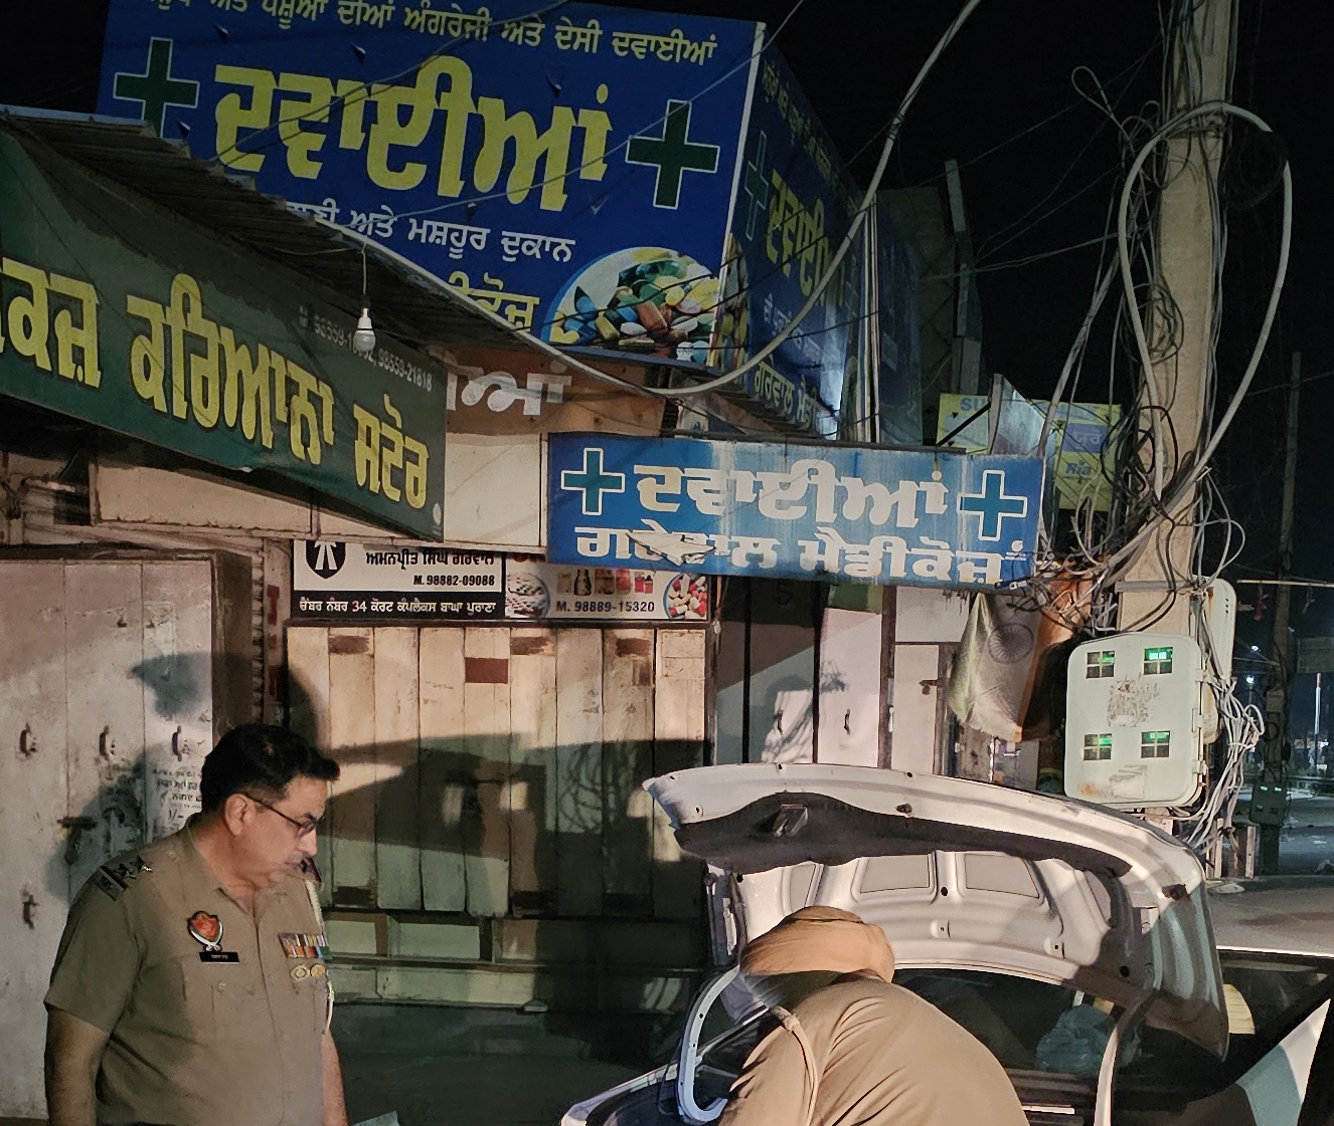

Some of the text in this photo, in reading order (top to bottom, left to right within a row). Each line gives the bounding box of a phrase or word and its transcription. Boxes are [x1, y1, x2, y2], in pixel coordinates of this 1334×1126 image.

[501, 15, 545, 47] ਅਤੇ
[554, 16, 603, 54] ਦੇਸੀ
[612, 28, 718, 66] ਦਵਾਈਆਂ
[213, 56, 613, 213] ਦਵਾਈਆਂ
[350, 204, 398, 238] ਅਤੇ
[408, 217, 490, 259] ਮਸ਼ਹੂਰ
[501, 230, 576, 262] ਦੁਕਾਨ
[127, 273, 336, 467] ਕਰਿਆਨਾ
[353, 394, 430, 510] ਸਟੋਰ
[633, 458, 952, 529] ਦਵਾਈਆਂ
[426, 575, 495, 586] 98882-09088
[798, 526, 1004, 585] ਮੈਡੀਕੋਜ਼
[326, 597, 348, 612] ਨੰਬਰ
[352, 602, 367, 612] 34
[370, 597, 393, 612] ਕੋਰਟ
[556, 601, 655, 613] M. 98889-15320
